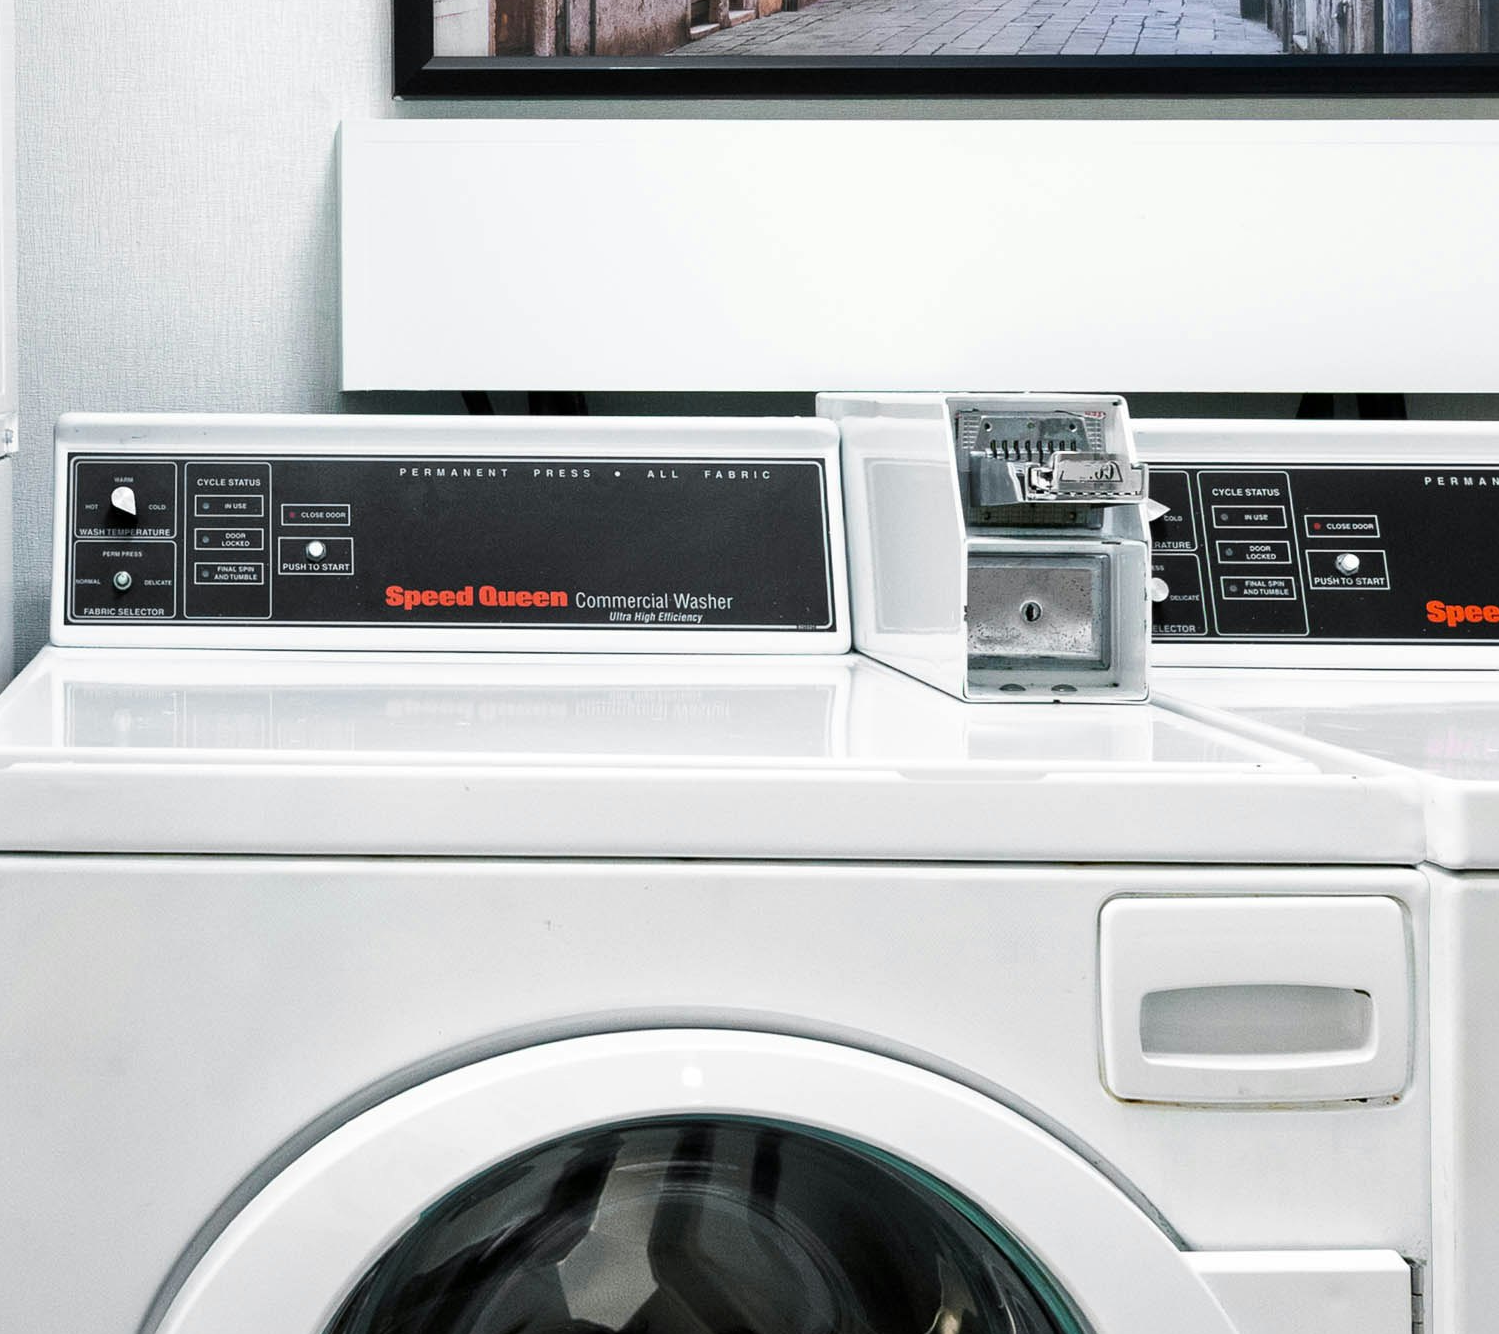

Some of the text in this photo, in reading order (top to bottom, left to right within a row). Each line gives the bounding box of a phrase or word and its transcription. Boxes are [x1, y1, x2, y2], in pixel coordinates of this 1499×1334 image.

[400, 468, 771, 480] PERMANENT PRESS ALL FABRIC
[385, 586, 733, 610] Speed Queen Commercial Washer
[609, 612, 703, 624] Ultra High Efficiency
[1153, 625, 1196, 633] ELECTOR
